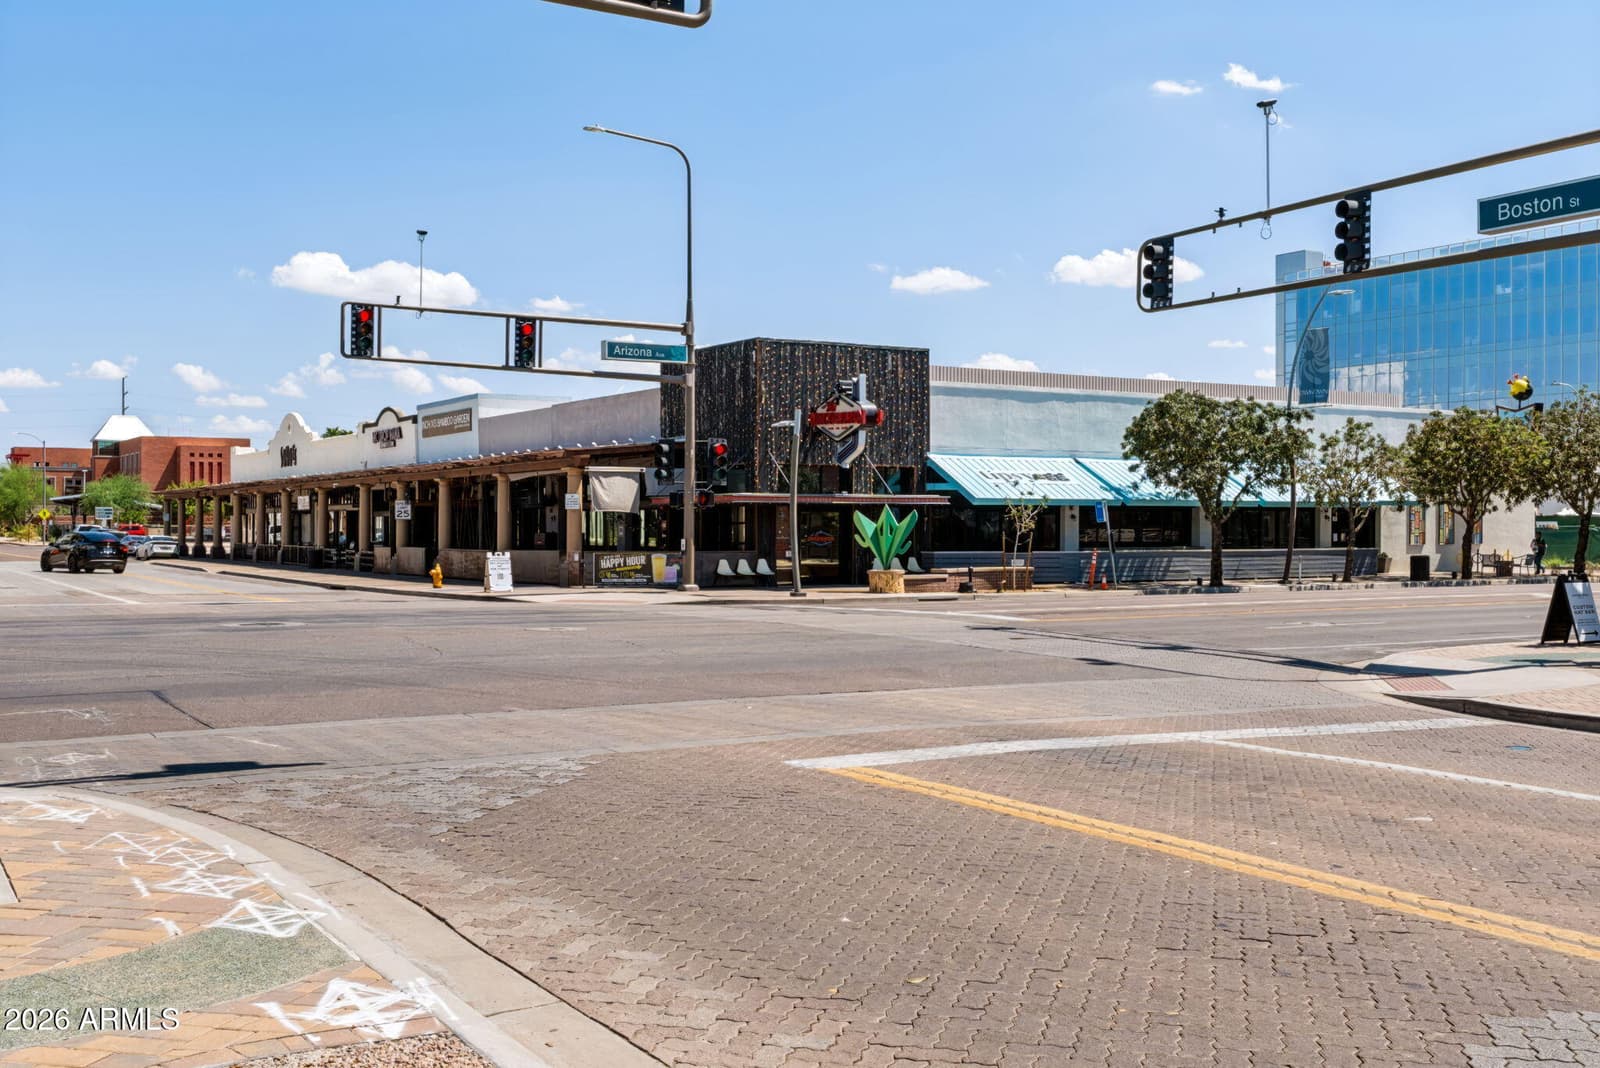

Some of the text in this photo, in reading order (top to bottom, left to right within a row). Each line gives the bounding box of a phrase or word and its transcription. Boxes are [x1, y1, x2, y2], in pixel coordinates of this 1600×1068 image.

[1498, 196, 1580, 221] Boston St
[613, 345, 653, 357] Arizona
[396, 510, 410, 518] 25
[600, 557, 624, 569] HAPPY
[626, 555, 647, 566] HOUR
